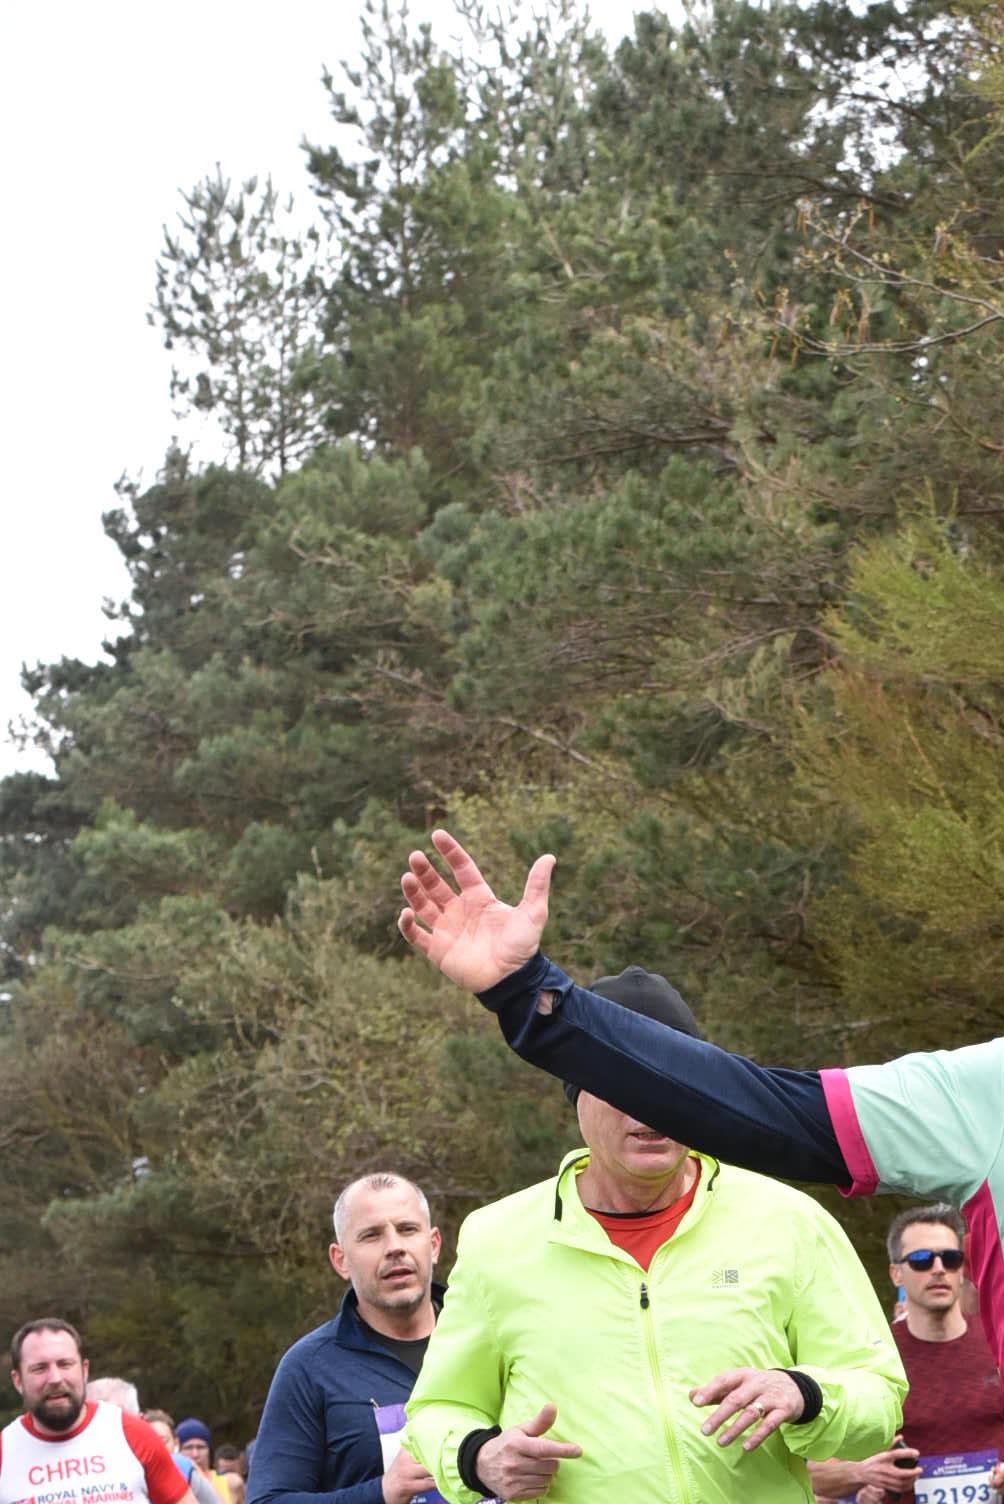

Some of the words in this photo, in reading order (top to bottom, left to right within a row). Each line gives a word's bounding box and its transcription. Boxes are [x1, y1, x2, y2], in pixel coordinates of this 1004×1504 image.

[28, 1455, 106, 1486] CHRIS
[37, 1489, 79, 1504] ROYAL
[81, 1483, 116, 1496] NAVY
[82, 1491, 134, 1504] MARINES
